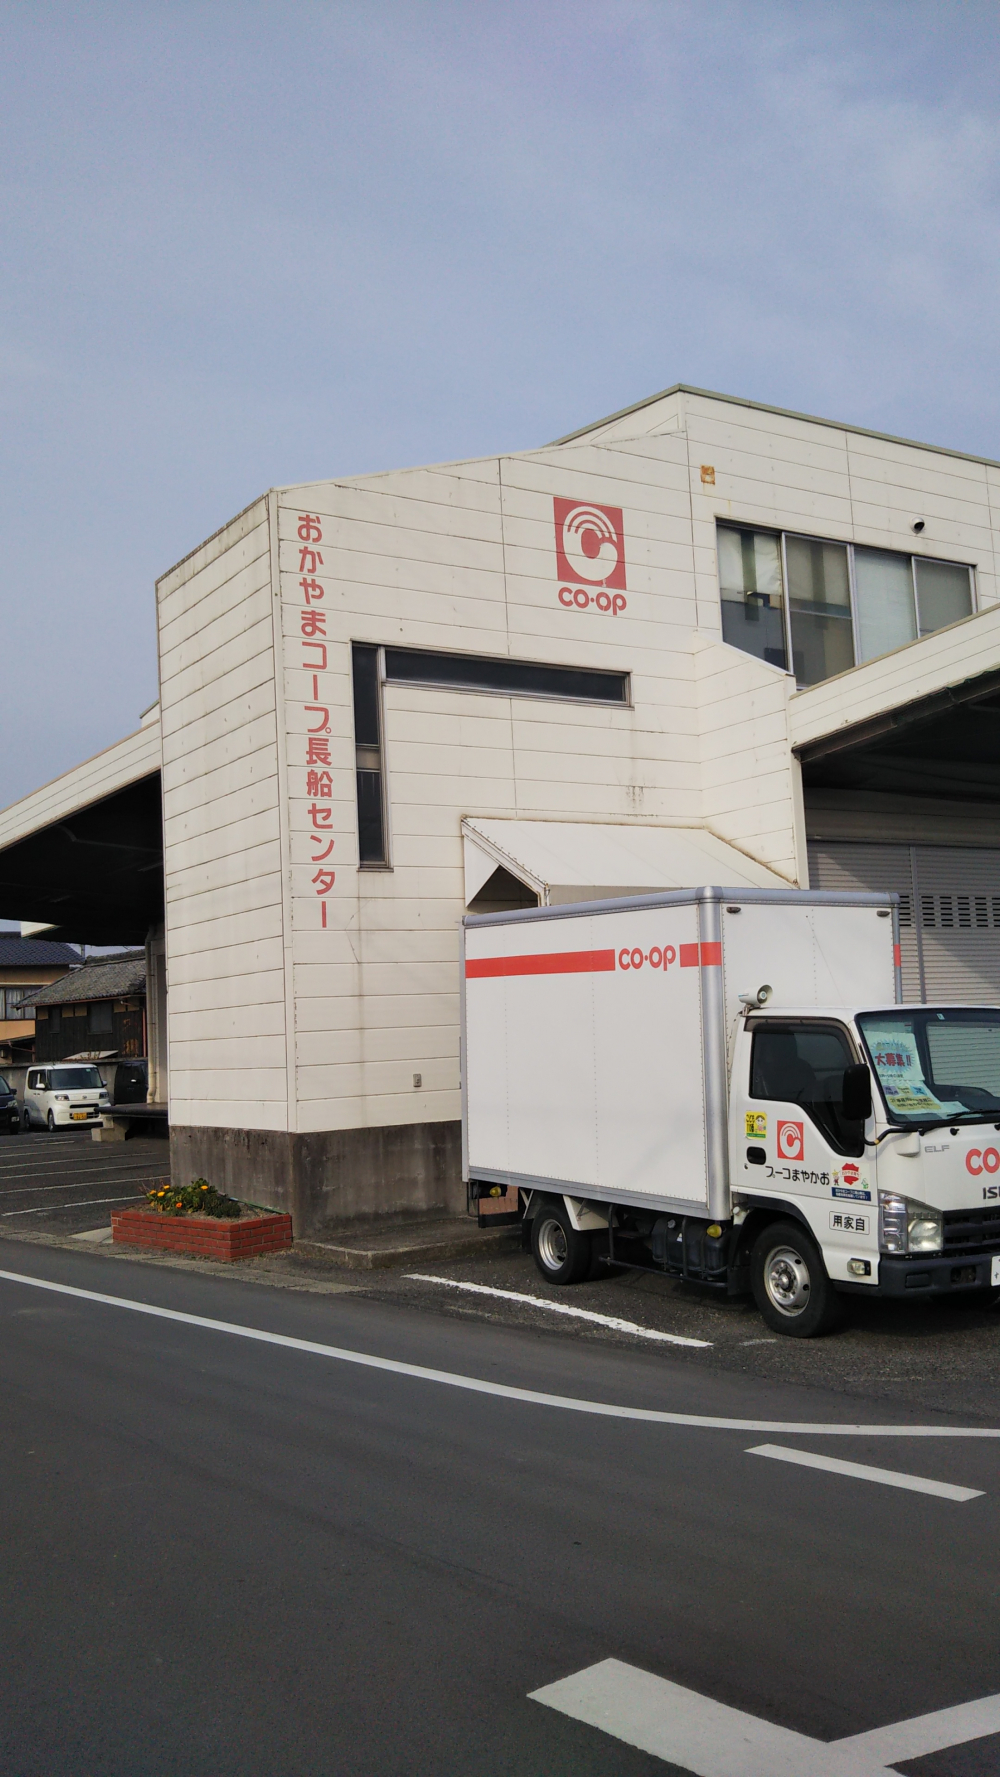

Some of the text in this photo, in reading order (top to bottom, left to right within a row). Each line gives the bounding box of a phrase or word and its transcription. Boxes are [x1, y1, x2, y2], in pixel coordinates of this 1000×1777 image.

[297, 514, 336, 929] おかやまコープ長船センター
[924, 1144, 950, 1153] ELF
[982, 1185, 1000, 1200] IS
